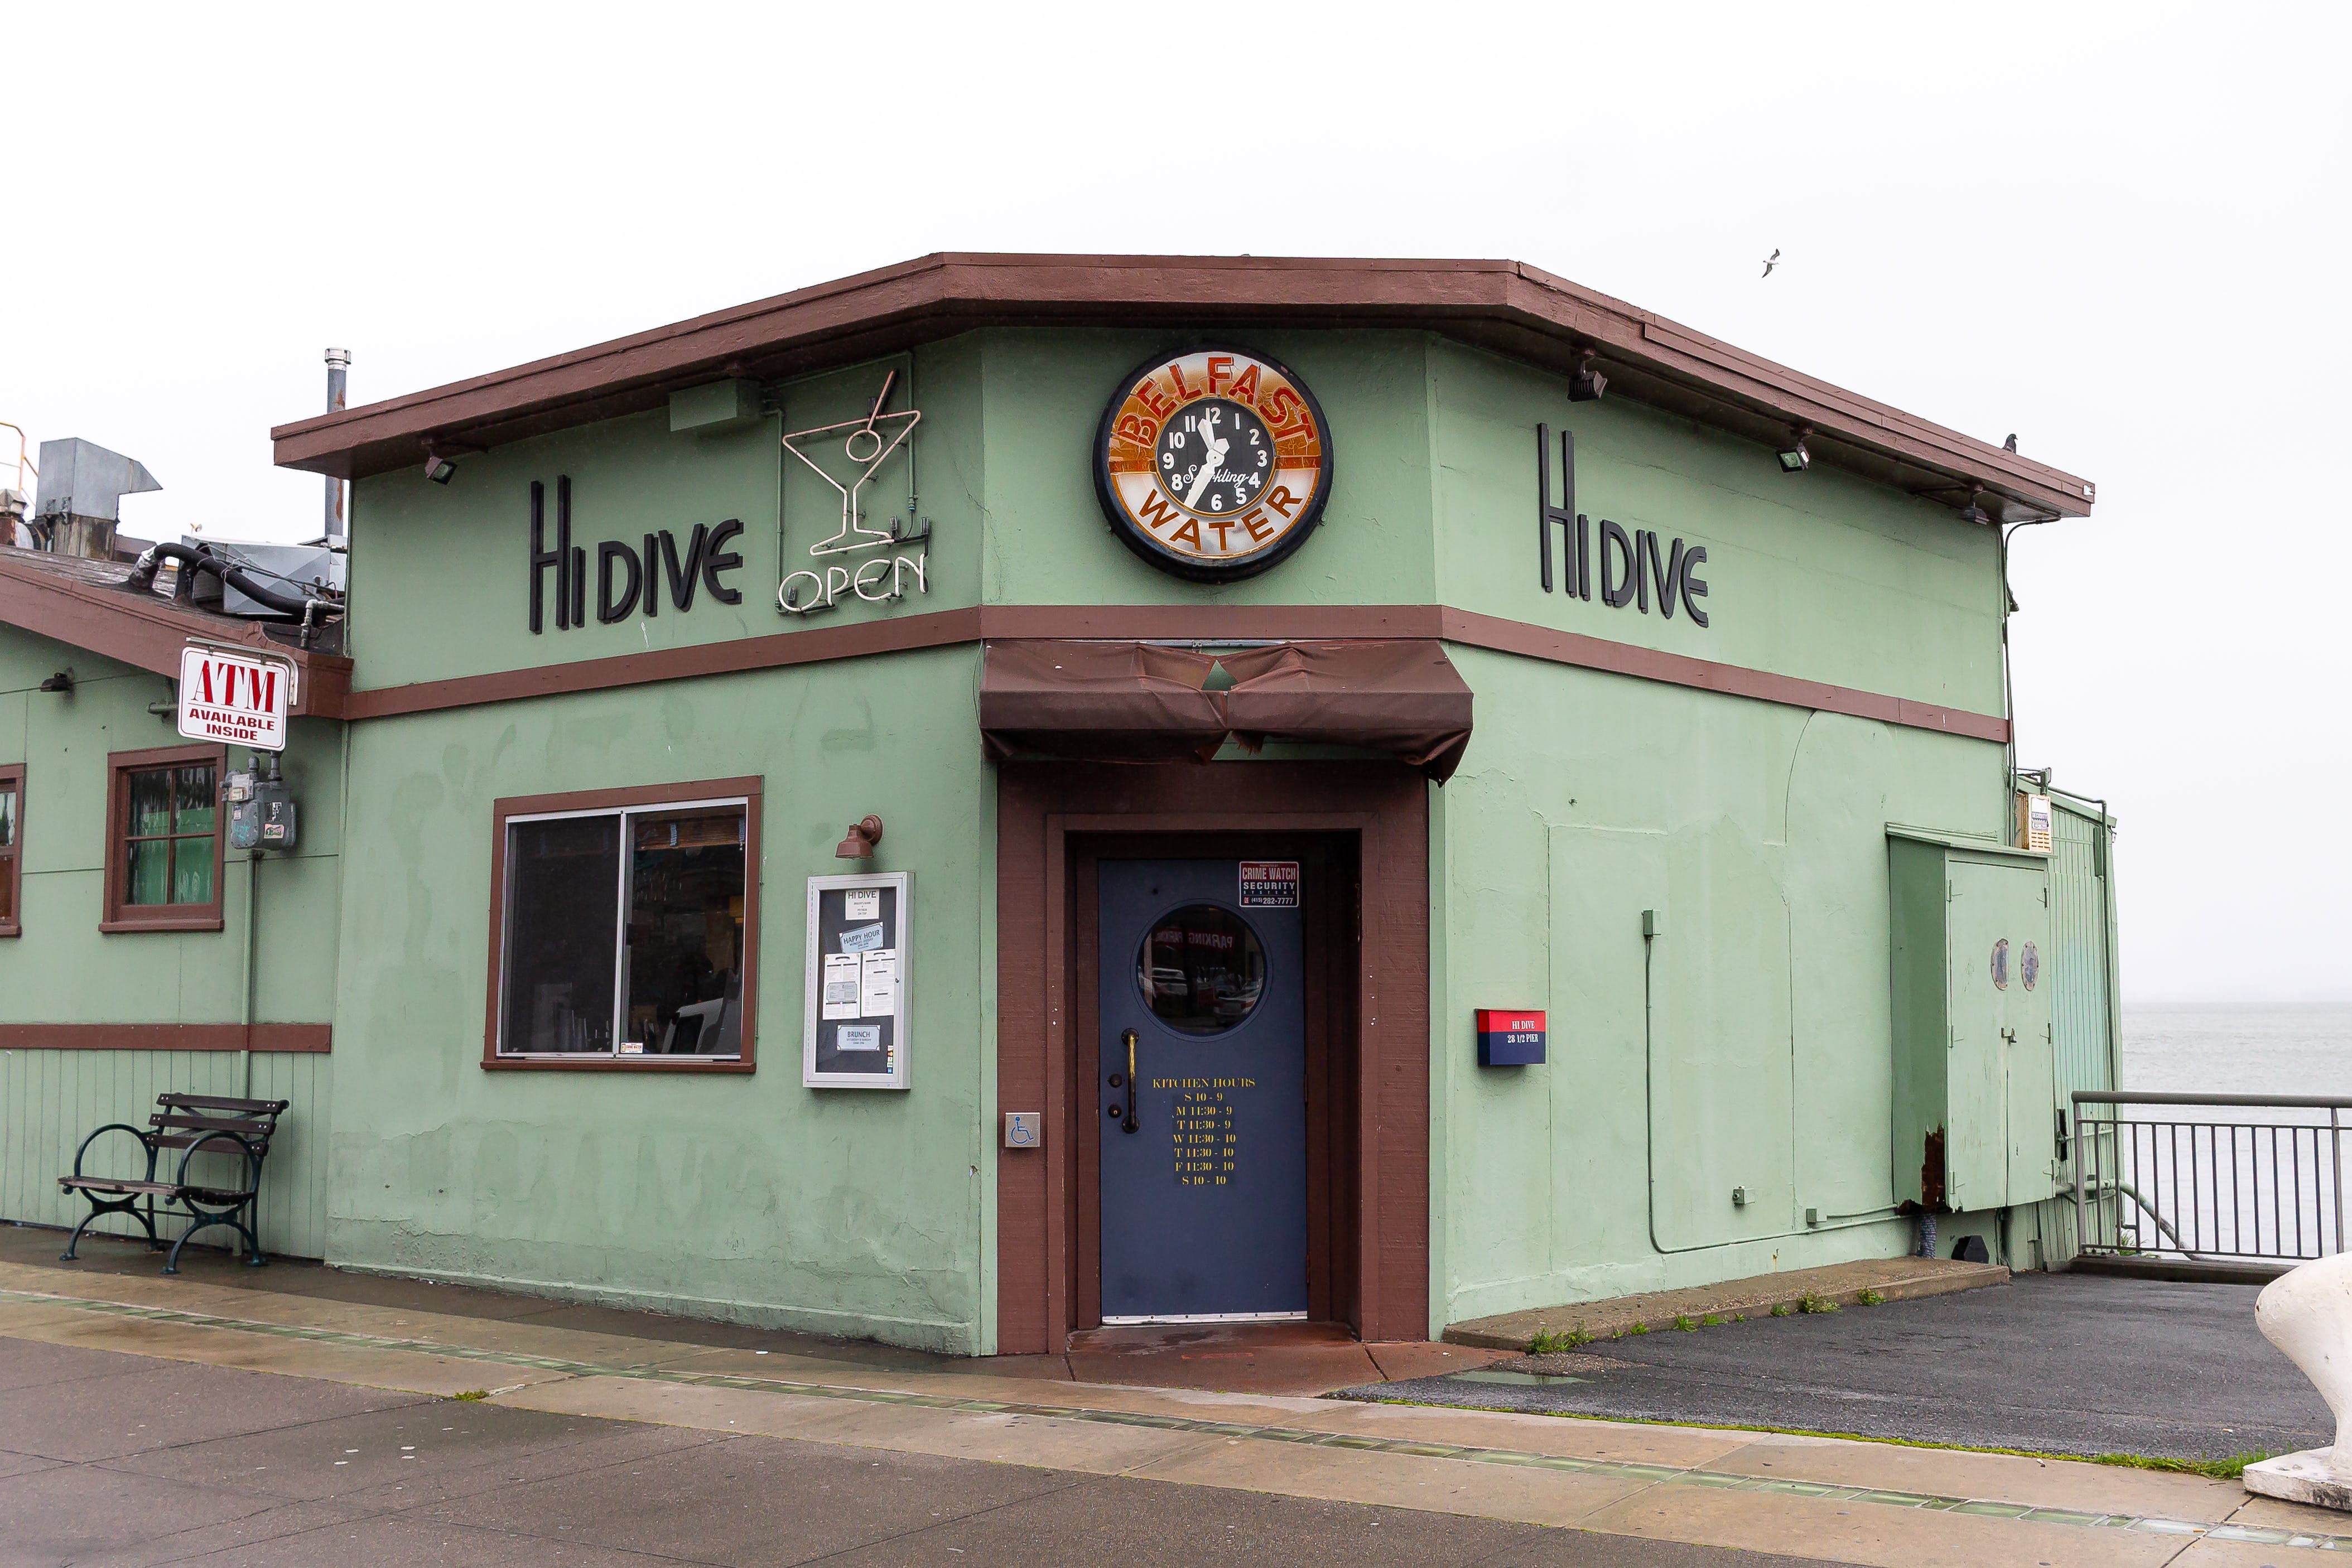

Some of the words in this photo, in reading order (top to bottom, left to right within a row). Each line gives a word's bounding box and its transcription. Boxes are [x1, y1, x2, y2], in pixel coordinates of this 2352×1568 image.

[1117, 357, 1315, 448] BELFAST
[1185, 415, 1196, 432] 11
[1206, 407, 1221, 424] 12
[1235, 413, 1240, 430] 1
[1169, 432, 1185, 449] 10
[1249, 428, 1260, 445] 2
[1162, 452, 1174, 470] 9
[1257, 450, 1267, 467] 3
[1172, 474, 1183, 491] 8
[1248, 472, 1261, 489] 4
[1211, 494, 1222, 511] 6
[1235, 488, 1247, 505] 5
[1139, 485, 1303, 551] WATER
[1538, 422, 1591, 601] HI
[1600, 519, 1709, 628] DIVE
[529, 474, 586, 635] HI
[596, 518, 744, 625] DIVE
[778, 553, 926, 612] OPEN
[190, 660, 279, 713] ATM
[189, 708, 275, 731] AVAILABLE
[206, 723, 258, 741] INSIDE
[1242, 867, 1267, 880] CRIME
[1269, 867, 1296, 880] WATCH
[843, 934, 862, 944] HAPPY
[864, 929, 880, 939] HOUR
[1511, 1021, 1520, 1029] HI
[1521, 1020, 1535, 1029] DIVE
[1507, 1035, 1516, 1043] 28
[1517, 1034, 1525, 1043] 1/2
[1526, 1034, 1539, 1042] PIER
[1152, 1078, 1209, 1088] KITCHEN
[1213, 1078, 1255, 1088] HOURS
[1184, 1092, 1192, 1102] S
[1196, 1092, 1206, 1102] 10
[1217, 1092, 1223, 1102] 9
[1177, 1106, 1185, 1116] M
[1191, 1106, 1216, 1116] 11:30
[1226, 1106, 1232, 1116] 9
[1177, 1120, 1185, 1130] T
[1189, 1120, 1214, 1130] 11:30
[1225, 1120, 1231, 1130] 9
[1173, 1134, 1184, 1143] W
[1189, 1134, 1214, 1143] 11:30
[1226, 1134, 1236, 1143] 10
[1174, 1148, 1183, 1157] T
[1187, 1148, 1212, 1157] 11:30
[1223, 1148, 1234, 1157] 10
[1175, 1162, 1183, 1171] F
[1187, 1162, 1212, 1171] 11:30
[1223, 1162, 1234, 1171] 10
[1182, 1176, 1189, 1185] S
[1194, 1176, 1204, 1185] 10
[1216, 1176, 1226, 1185] 10
